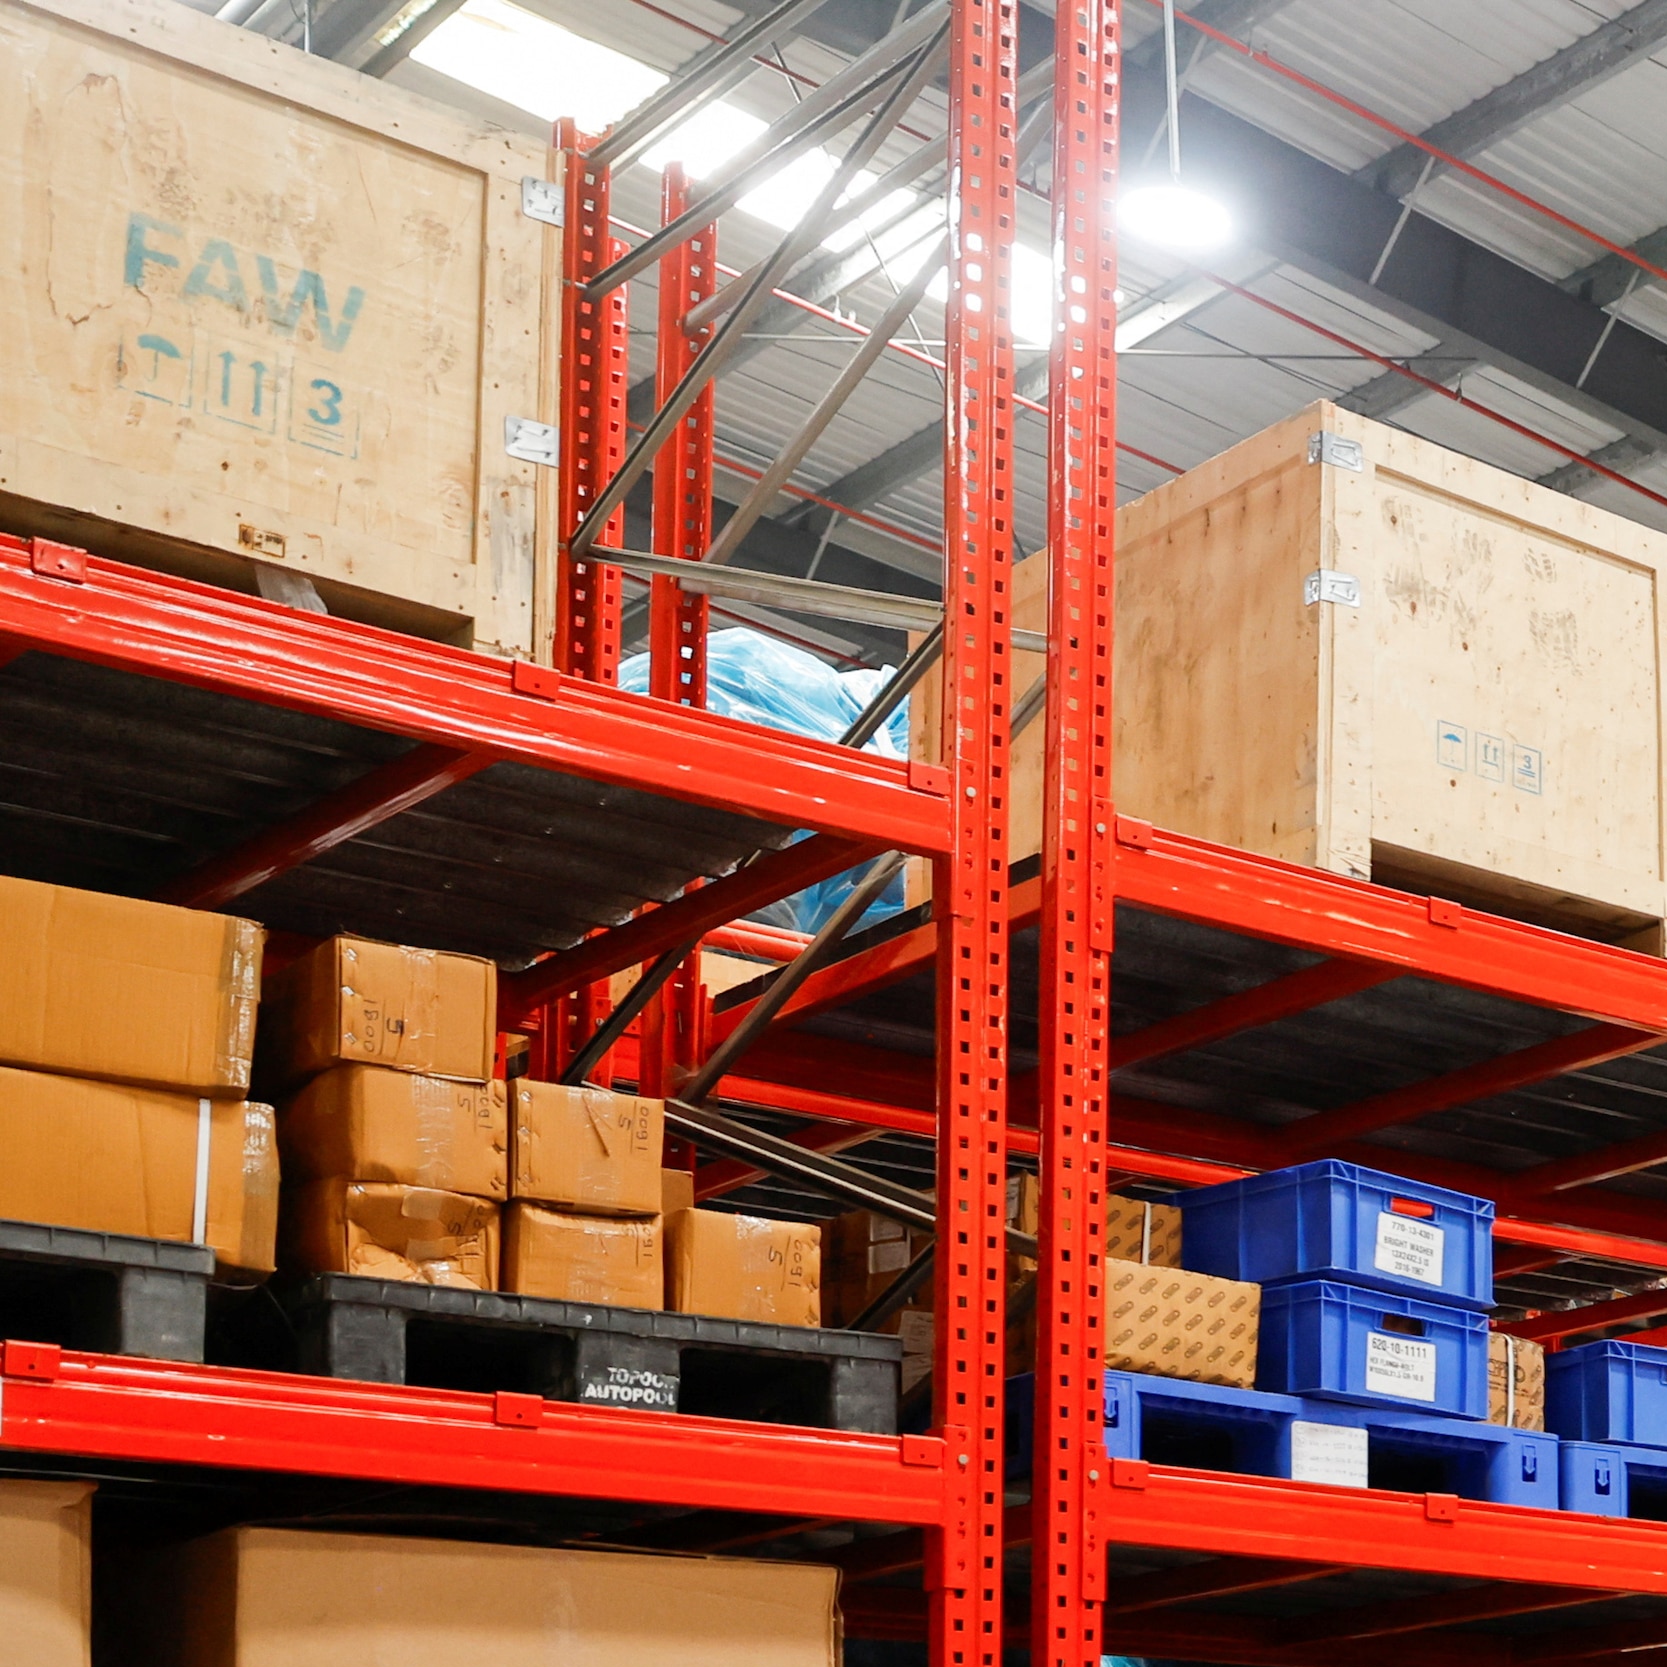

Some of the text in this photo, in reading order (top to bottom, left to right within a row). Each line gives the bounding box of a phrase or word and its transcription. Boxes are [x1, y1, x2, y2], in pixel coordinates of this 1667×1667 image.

[124, 211, 365, 353] FAW
[308, 379, 342, 425] 3
[1384, 1235, 1434, 1256] BRIGHT WASHER
[1372, 1337, 1427, 1359] 620-10-1111
